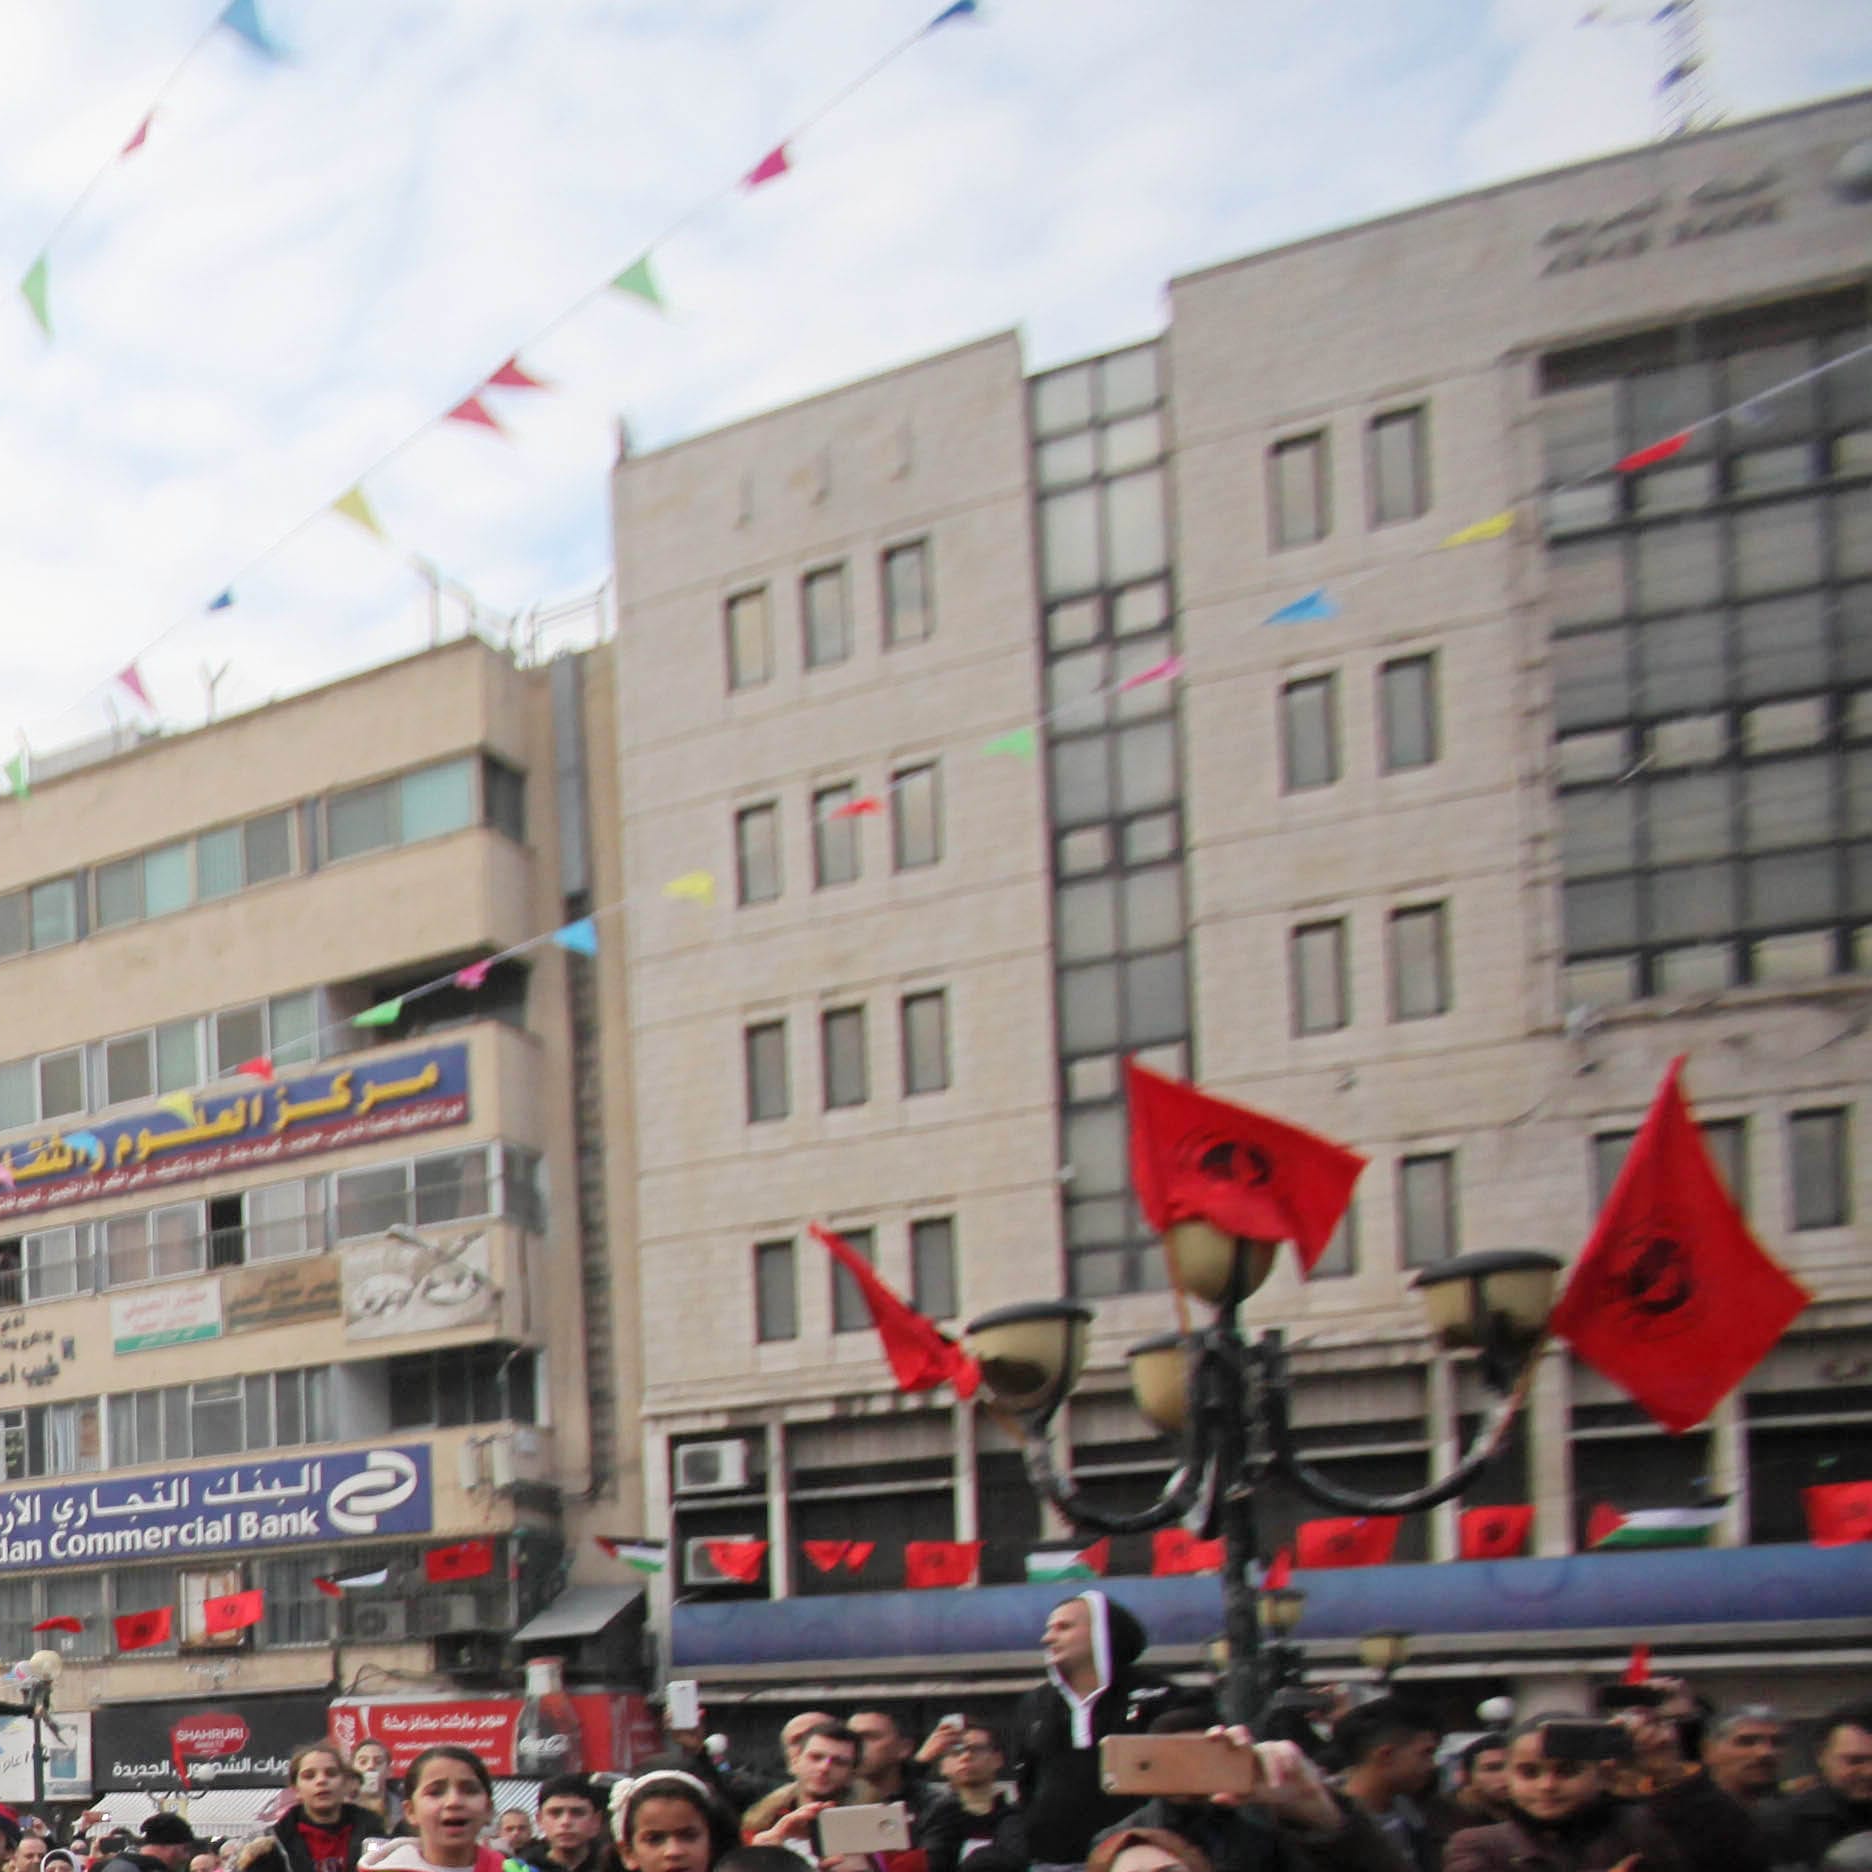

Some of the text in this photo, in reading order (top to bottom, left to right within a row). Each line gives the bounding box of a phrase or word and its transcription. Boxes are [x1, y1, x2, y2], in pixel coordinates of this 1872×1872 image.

[270, 1061, 439, 1134] مركز
[52, 1476, 191, 1527] التجاري
[202, 1461, 322, 1508] البنك
[49, 1512, 233, 1561] Commercial
[238, 1505, 322, 1542] Bank
[175, 1727, 244, 1742] SHAHRURI
[112, 1759, 170, 1788] الجديدة
